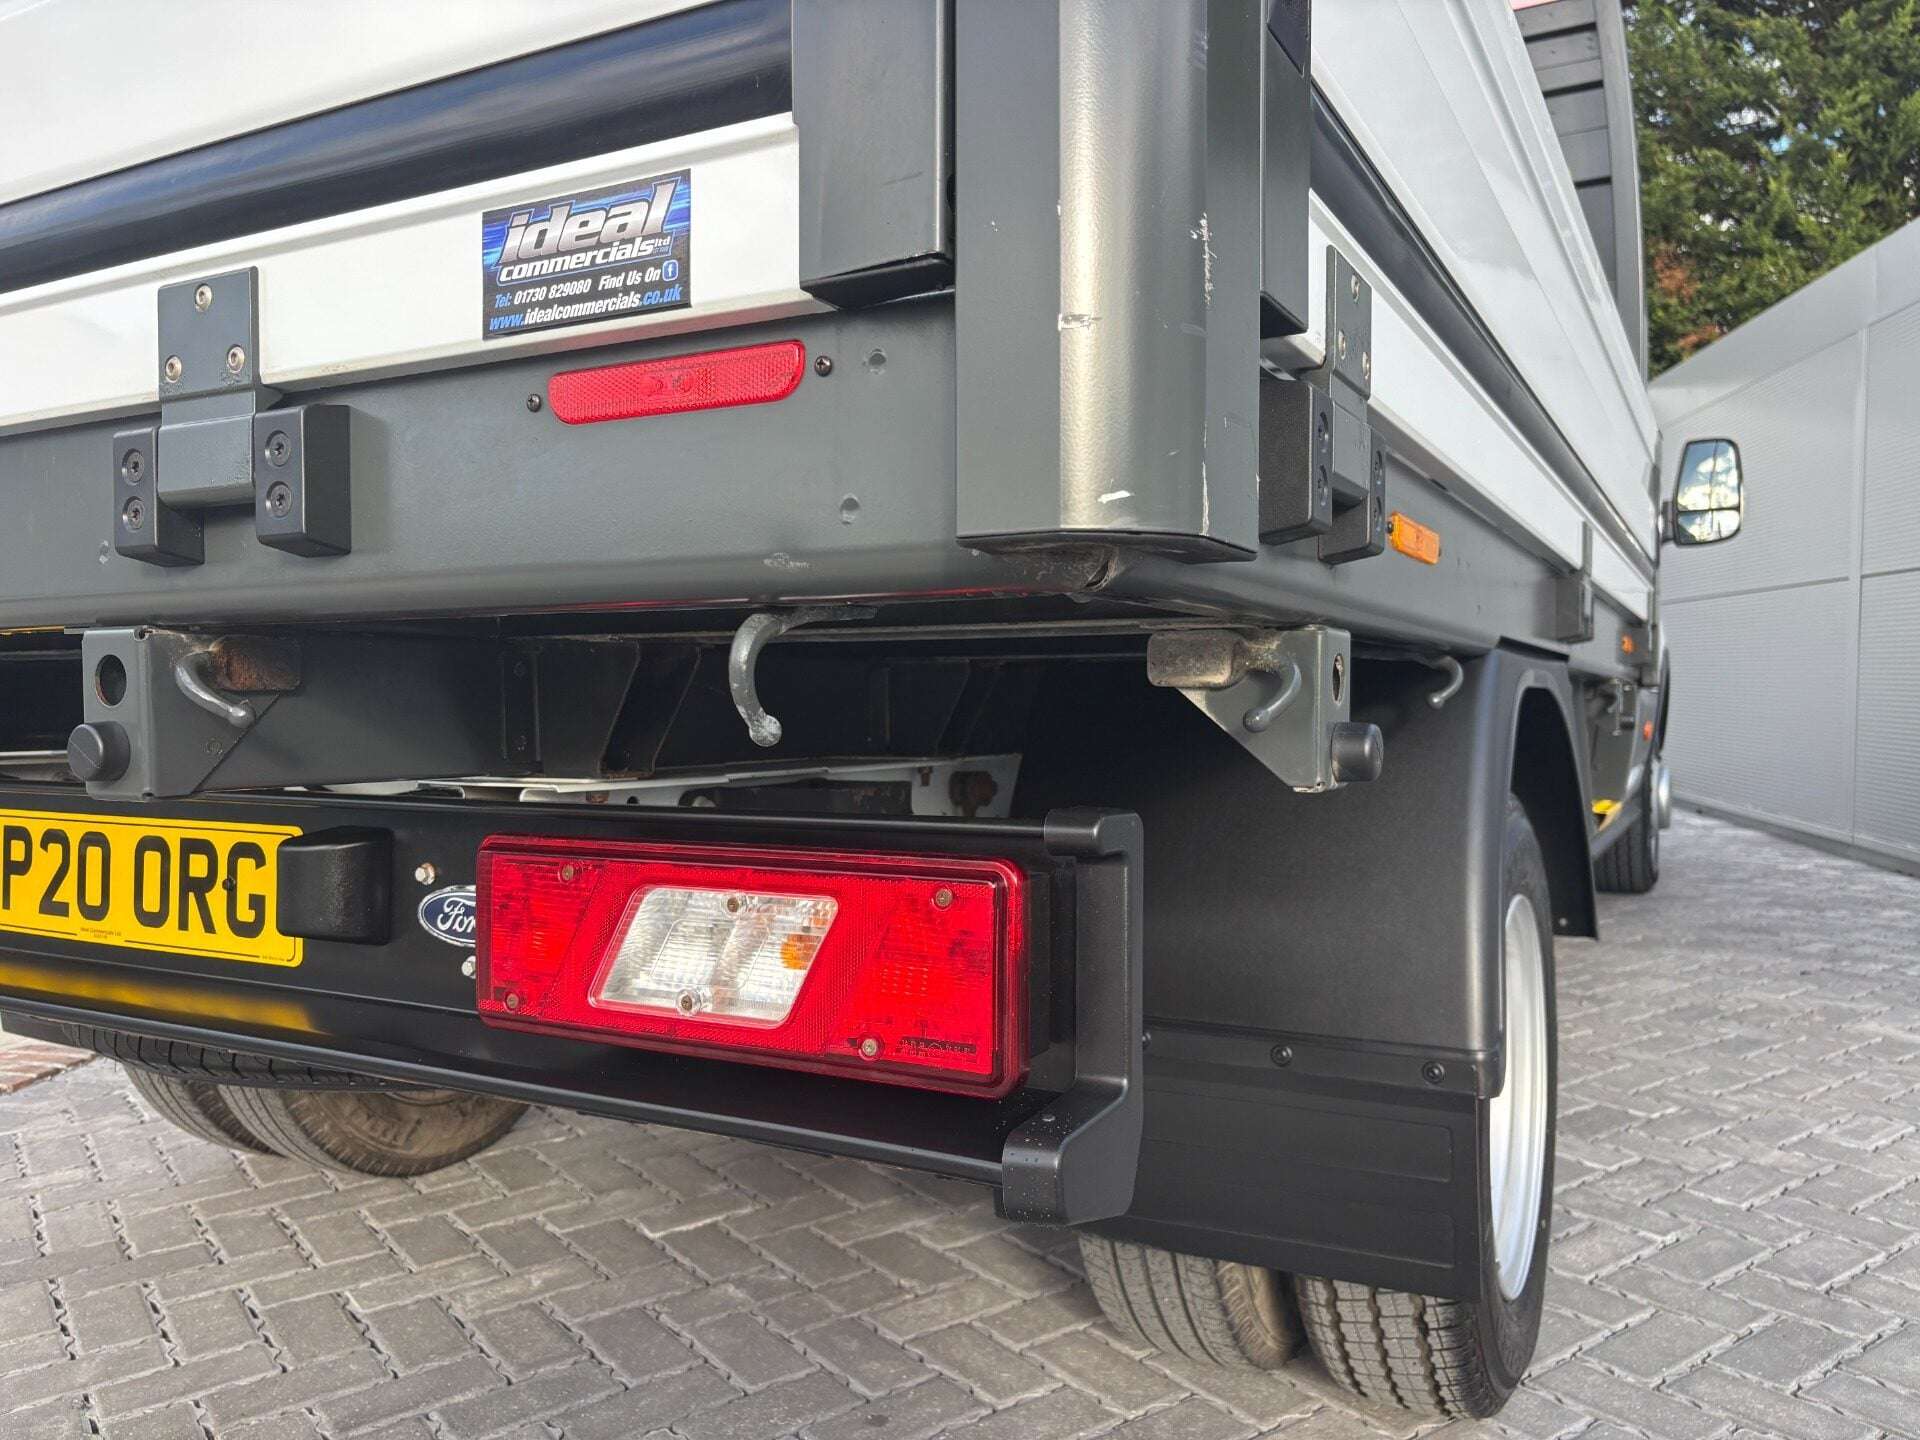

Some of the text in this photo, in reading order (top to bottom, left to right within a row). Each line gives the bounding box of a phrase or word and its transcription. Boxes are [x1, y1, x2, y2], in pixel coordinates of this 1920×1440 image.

[499, 182, 676, 263] ideal
[500, 237, 655, 281] commercials
[489, 284, 683, 330] www.idealcommercials.co.uk
[495, 292, 512, 308] Tel:
[514, 286, 547, 305] 01730
[549, 278, 592, 299] 829080
[598, 272, 626, 291] Find
[627, 270, 643, 286] Us
[644, 267, 662, 283] On
[2, 824, 267, 939] P20 ORG
[437, 896, 476, 933] For
